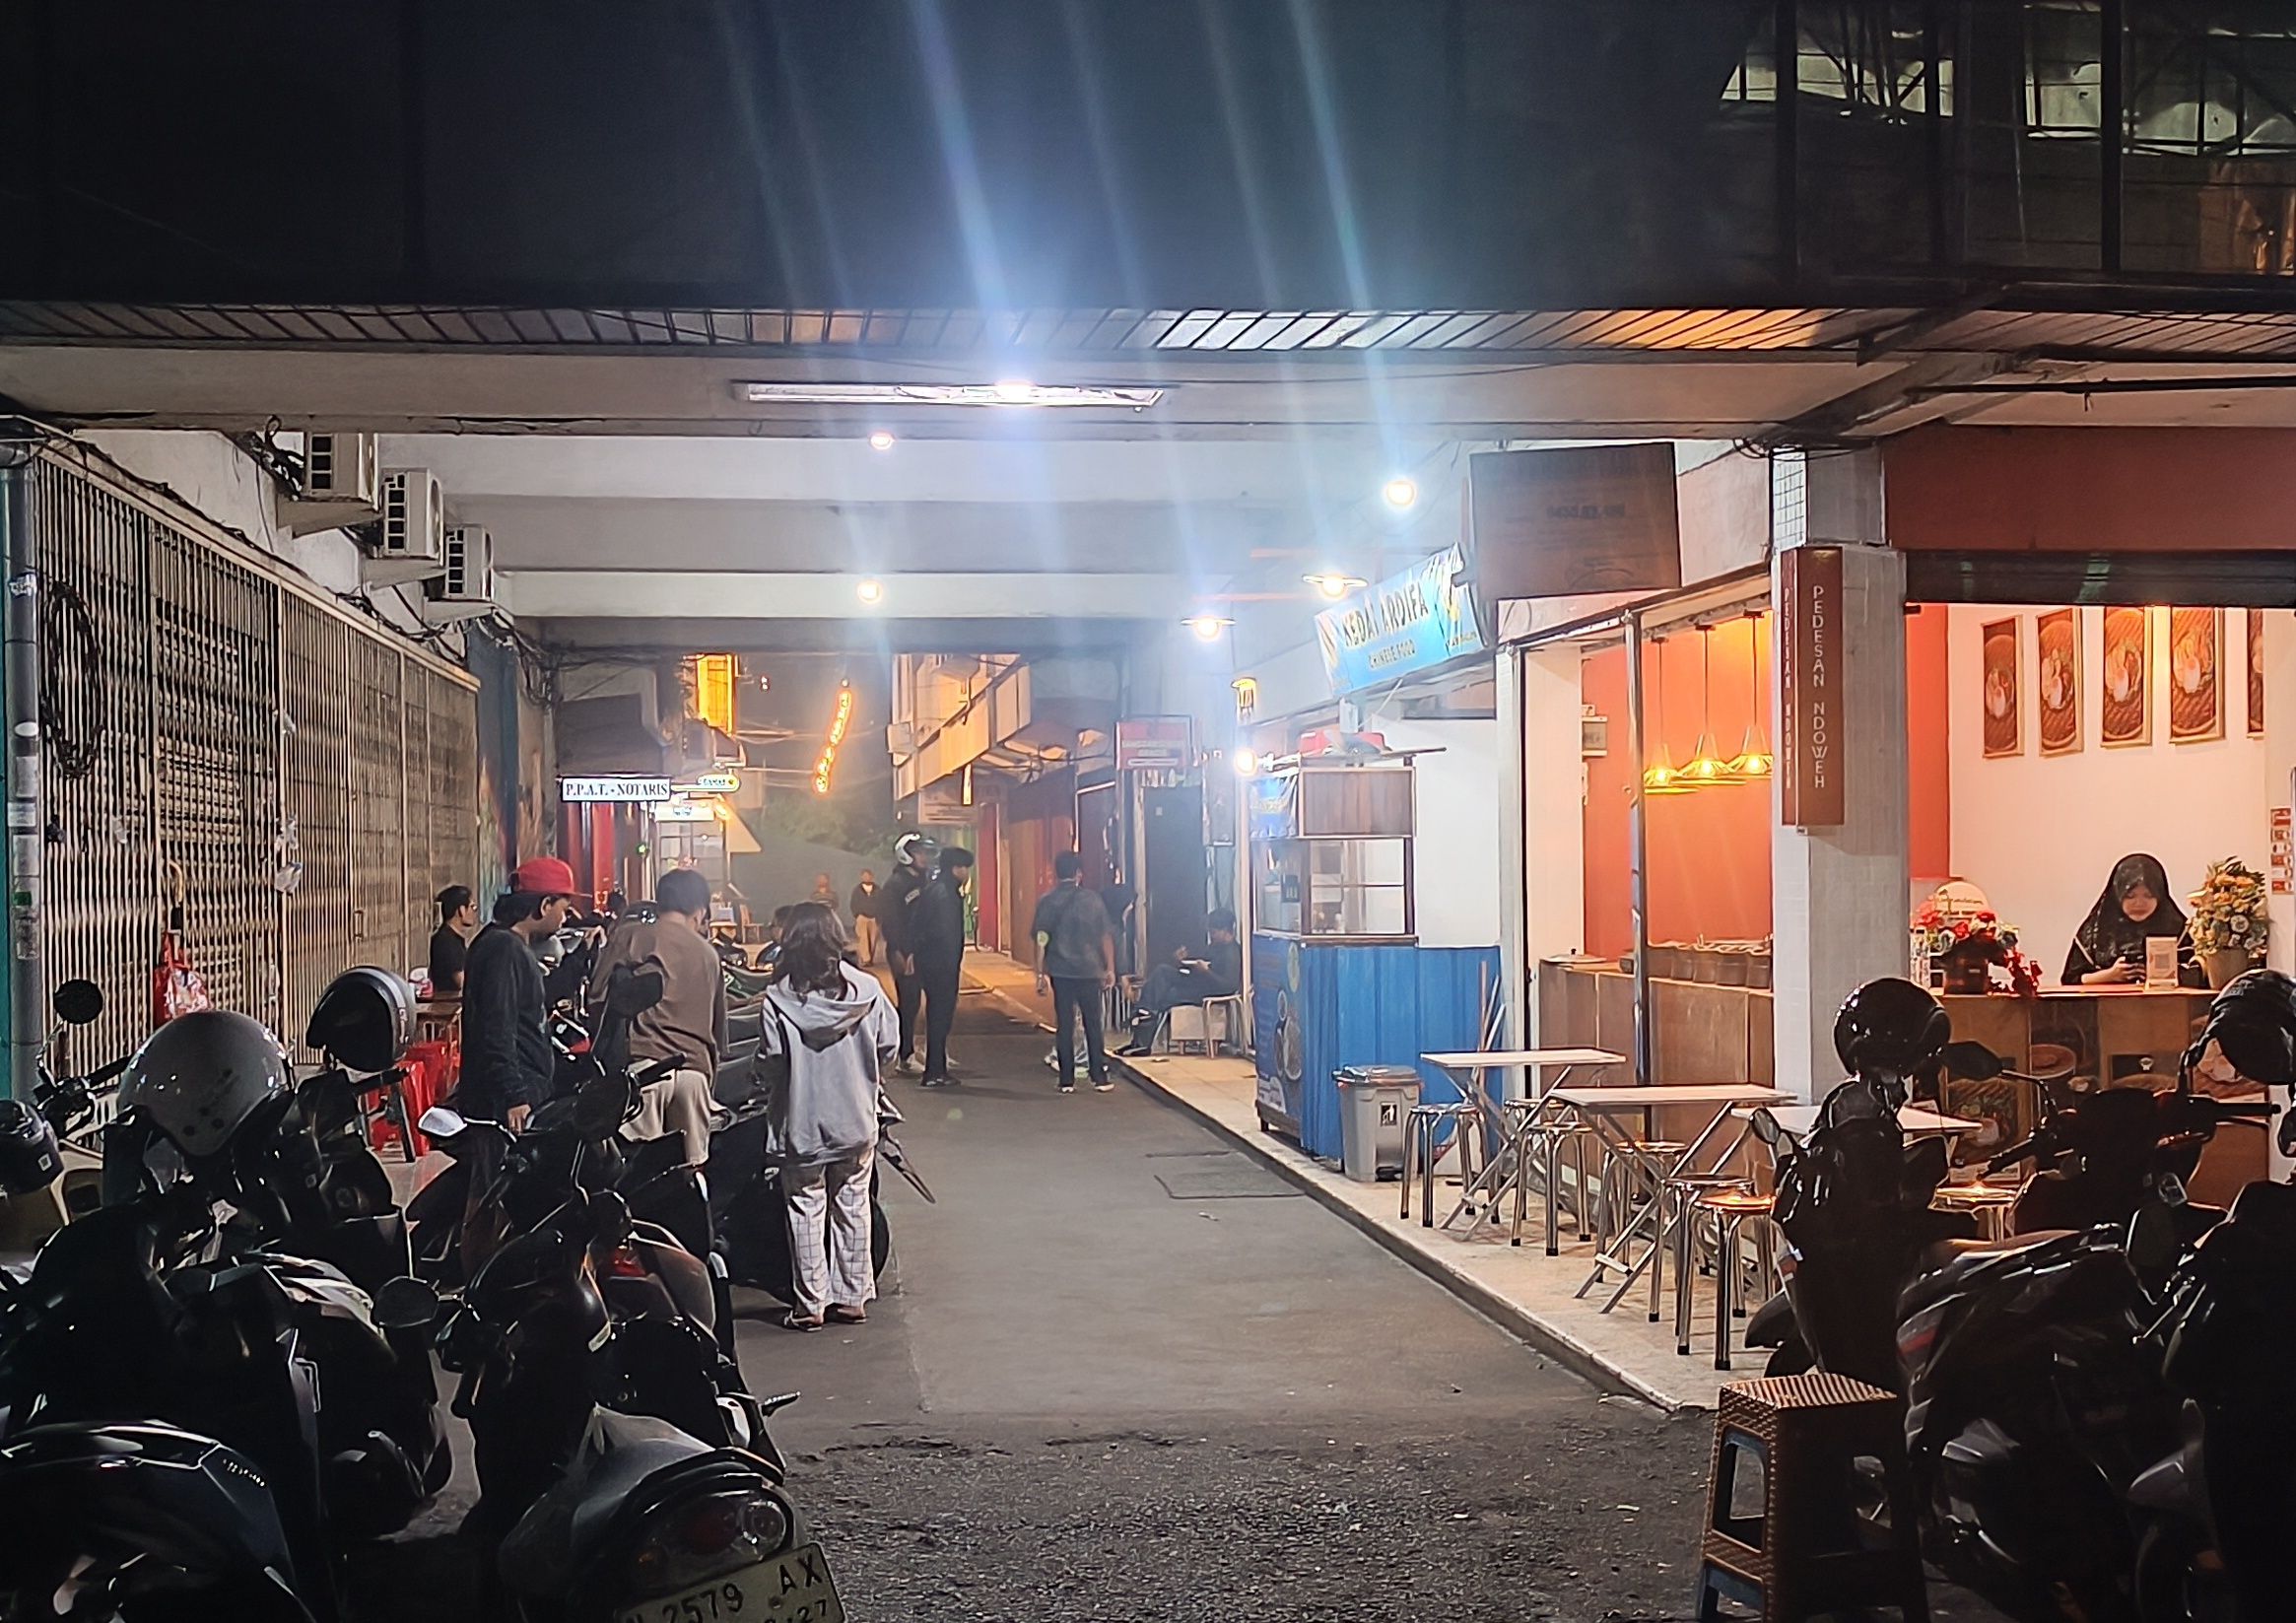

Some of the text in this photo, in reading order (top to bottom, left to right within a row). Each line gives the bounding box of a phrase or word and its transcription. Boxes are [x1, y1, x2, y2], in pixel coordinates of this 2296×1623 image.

[1341, 581, 1429, 647] KEDAI ARDIFA
[1811, 585, 1828, 788] PEDESAN NDOWEH
[617, 782, 668, 796] NOTARIS
[661, 1582, 744, 1623] 2579
